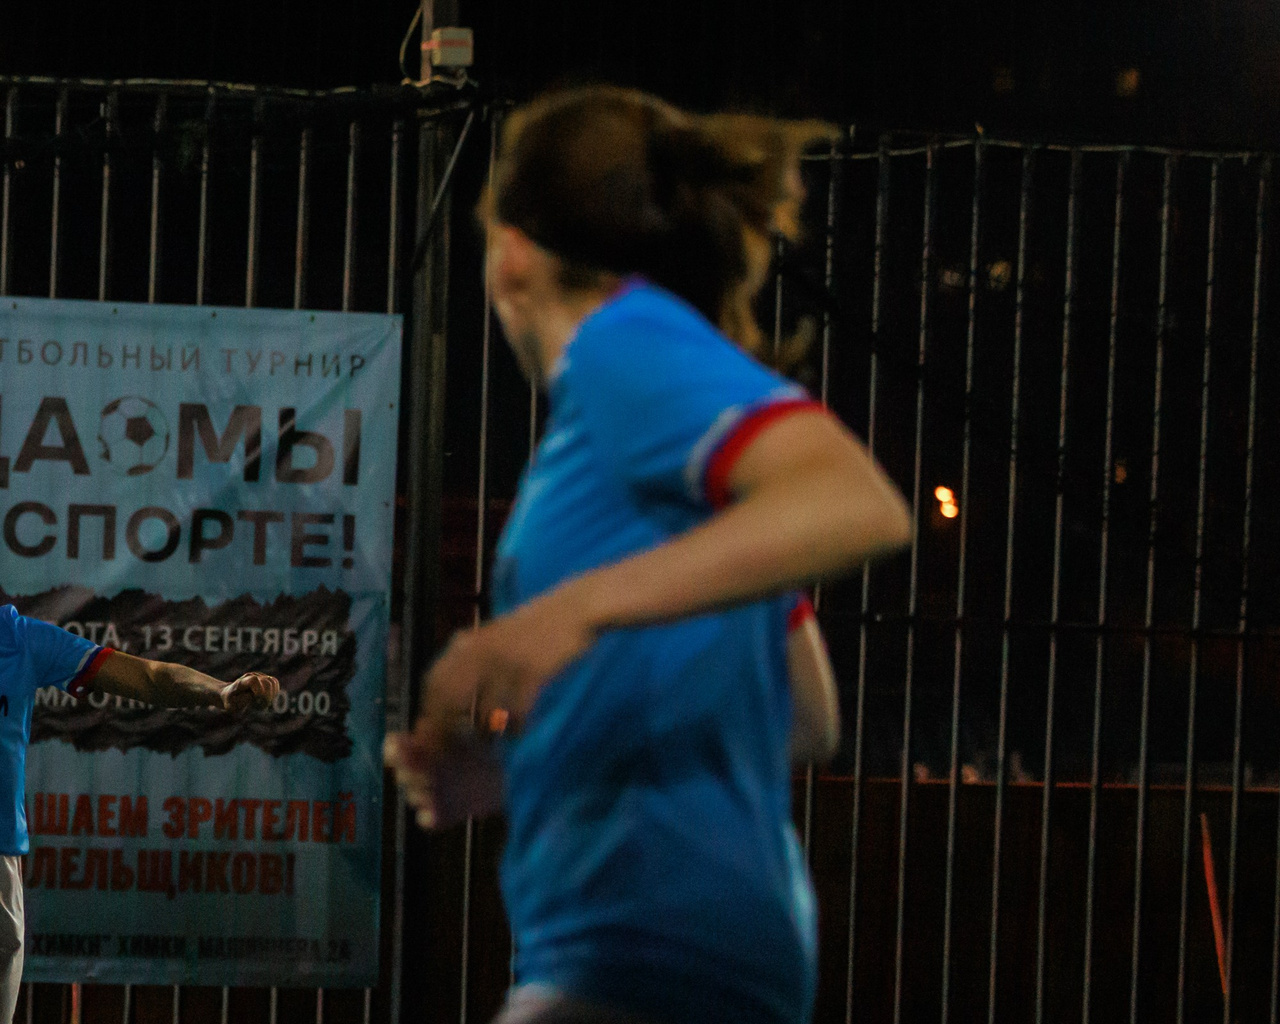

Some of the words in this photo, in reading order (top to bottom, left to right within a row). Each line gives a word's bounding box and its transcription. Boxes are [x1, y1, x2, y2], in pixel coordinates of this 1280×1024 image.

[221, 347, 366, 379] ТУРНИР
[2, 501, 356, 569] СПОРТЕ!
[141, 624, 173, 651] 13
[183, 624, 338, 656] СЕНТЯБРЯ
[25, 791, 149, 837] ШАЕМ
[162, 791, 357, 844] ЗРИТЕЛЕЙ
[22, 847, 296, 900] ЛЕЛЬЩИКОВ!
